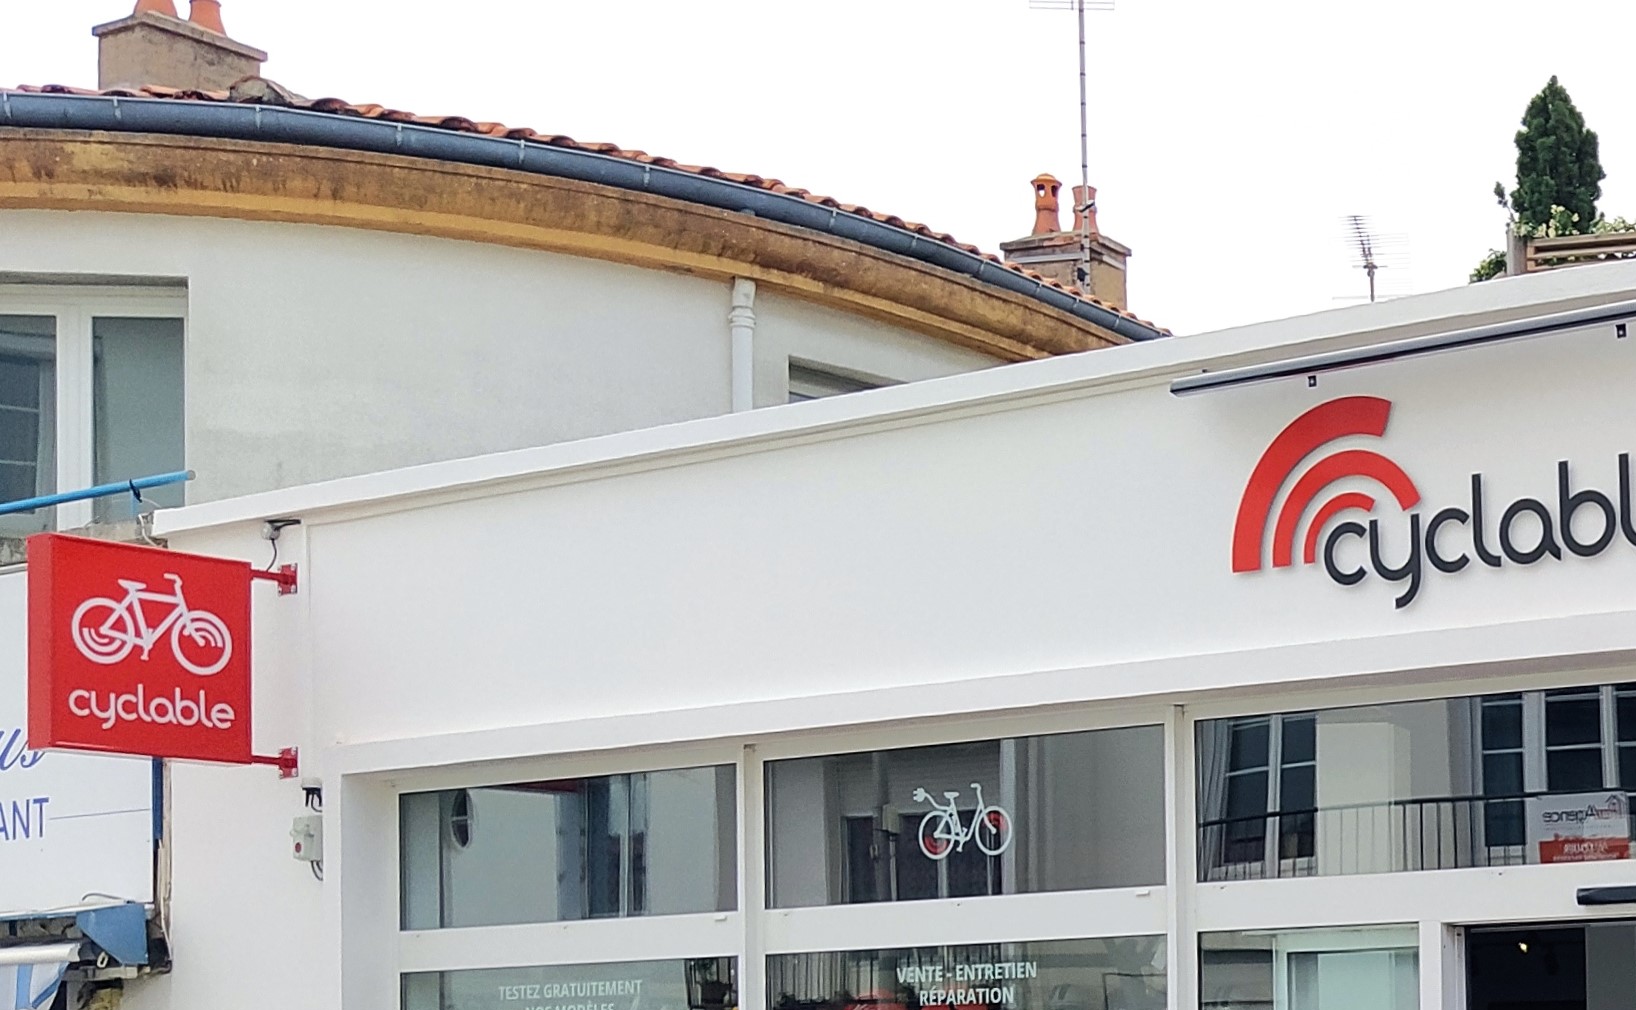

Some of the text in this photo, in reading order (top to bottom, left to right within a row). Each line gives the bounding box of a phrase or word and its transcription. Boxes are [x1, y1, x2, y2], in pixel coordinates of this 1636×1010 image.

[68, 684, 236, 730] cyclable
[896, 966, 943, 983] VENTE
[955, 962, 1037, 981] ENTRETIEN
[499, 980, 642, 1000] TESTEZ GRATUITEMENT
[919, 986, 1014, 1006] RÉPARATION
